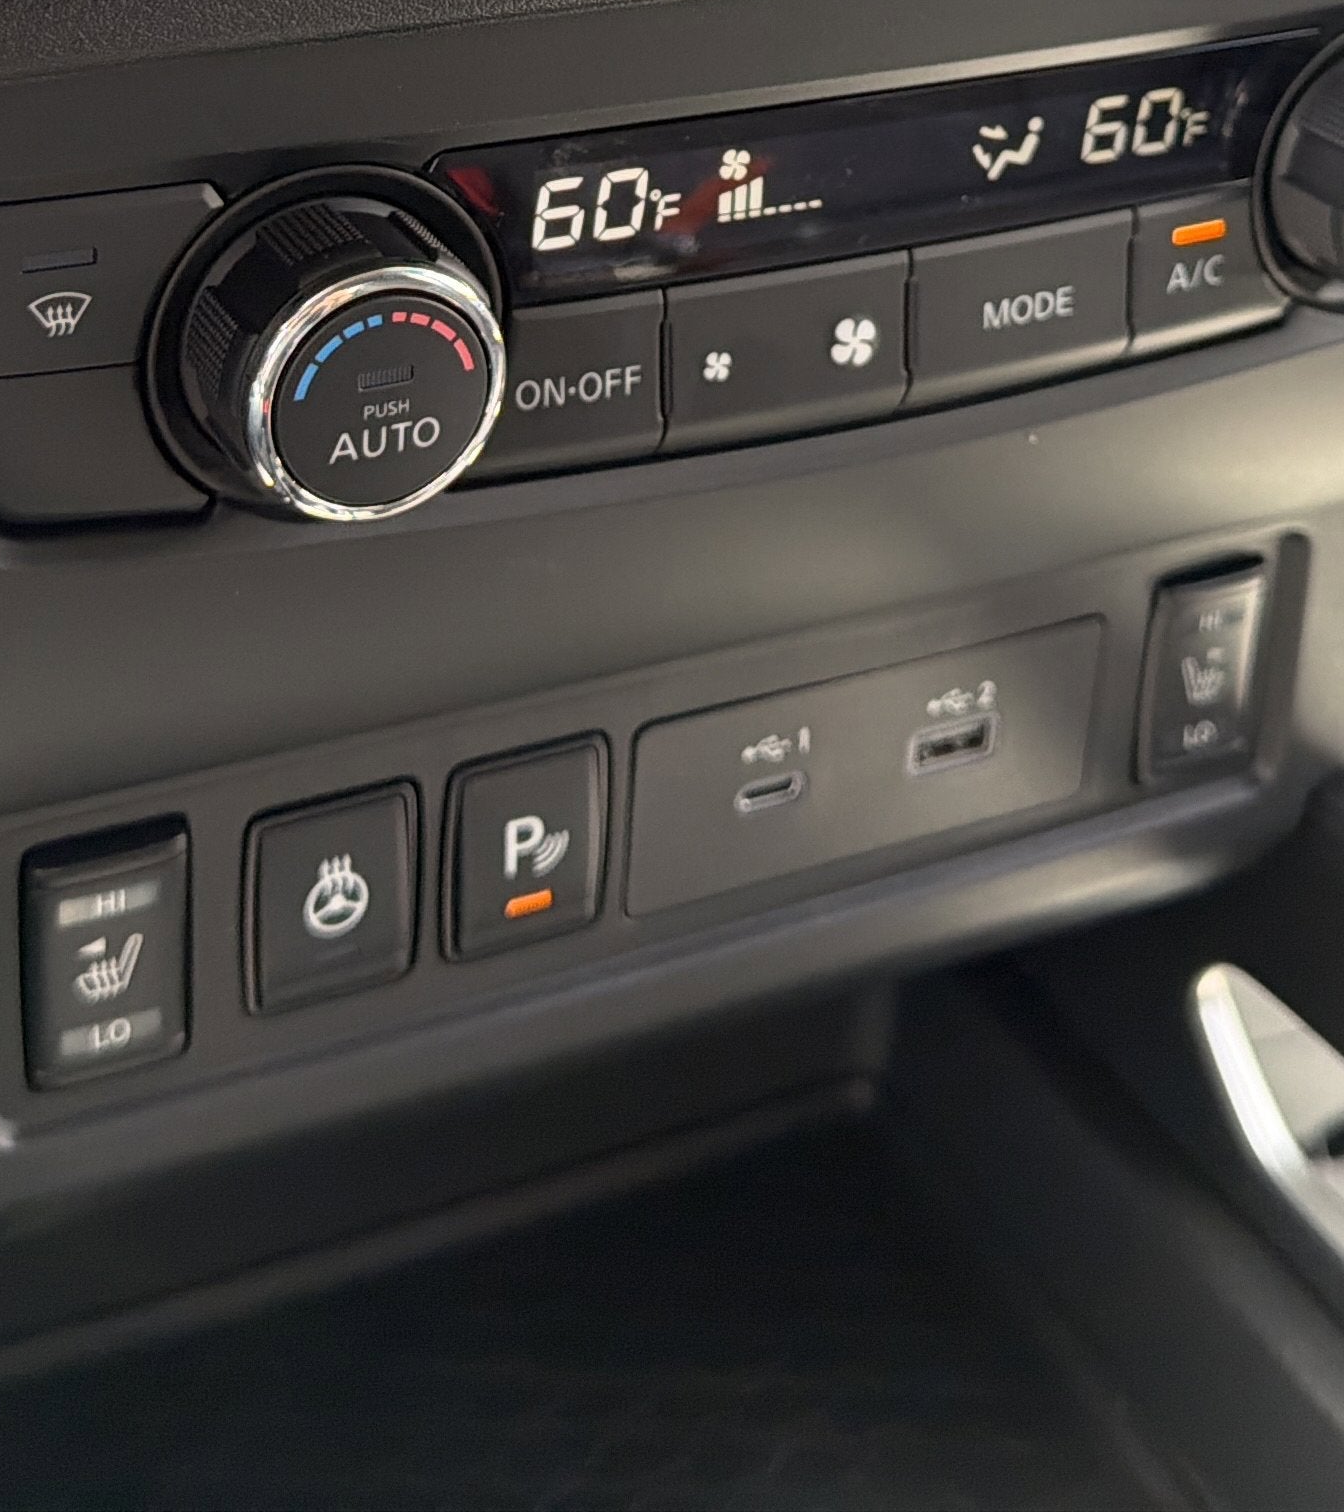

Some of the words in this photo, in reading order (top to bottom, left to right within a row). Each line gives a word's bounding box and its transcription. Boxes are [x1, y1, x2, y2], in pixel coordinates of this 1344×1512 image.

[1166, 255, 1225, 292] A/C
[983, 286, 1075, 329] MODE
[363, 398, 411, 421] PUSH
[329, 416, 441, 465] AUTO
[97, 890, 127, 914] HI
[91, 1018, 132, 1049] LO
